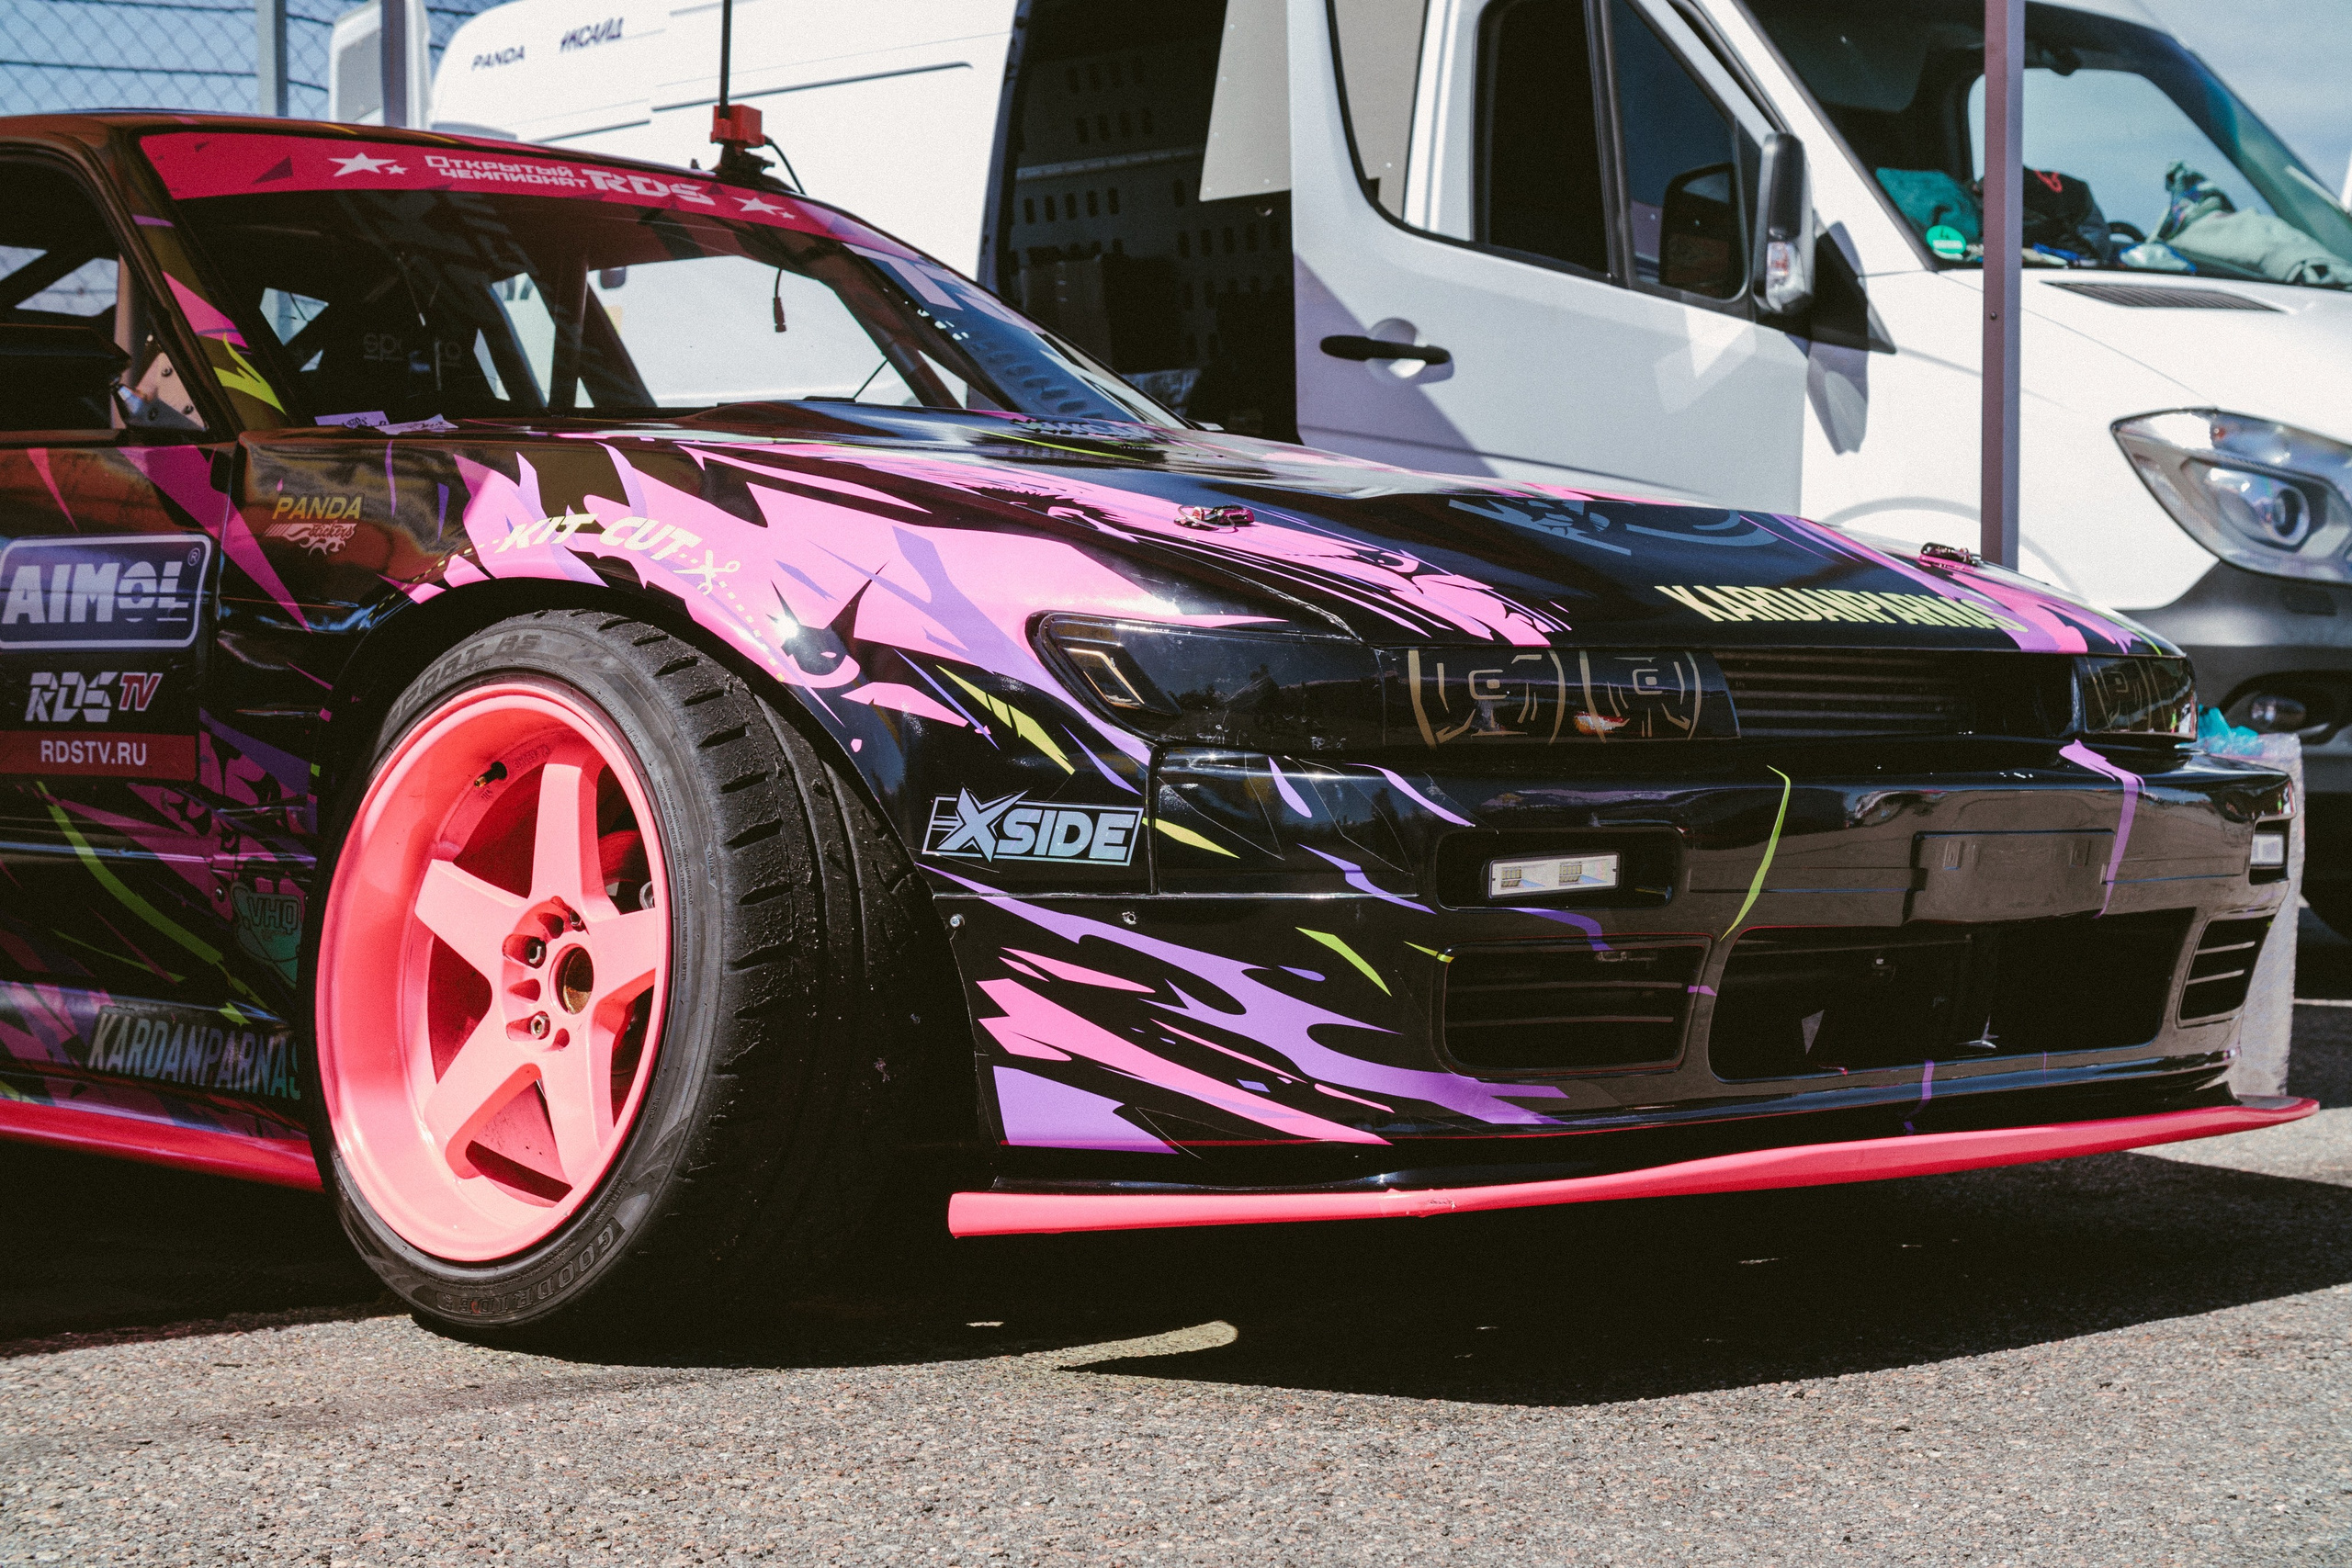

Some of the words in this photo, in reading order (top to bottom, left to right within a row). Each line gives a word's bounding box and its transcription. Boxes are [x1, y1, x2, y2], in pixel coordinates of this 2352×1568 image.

[470, 45, 525, 71] PANDA
[581, 168, 716, 206] RDS
[272, 496, 363, 521] PANDA
[494, 513, 599, 553] KIT
[599, 516, 703, 561] CUT
[2, 561, 189, 624] AIMOL
[1654, 585, 2030, 634] KARDANPARNAS
[119, 671, 164, 712] TV
[40, 739, 148, 767] RDSTV.RU
[935, 787, 1137, 863] XSIDE
[459, 1222, 616, 1315] GOODRIDE
